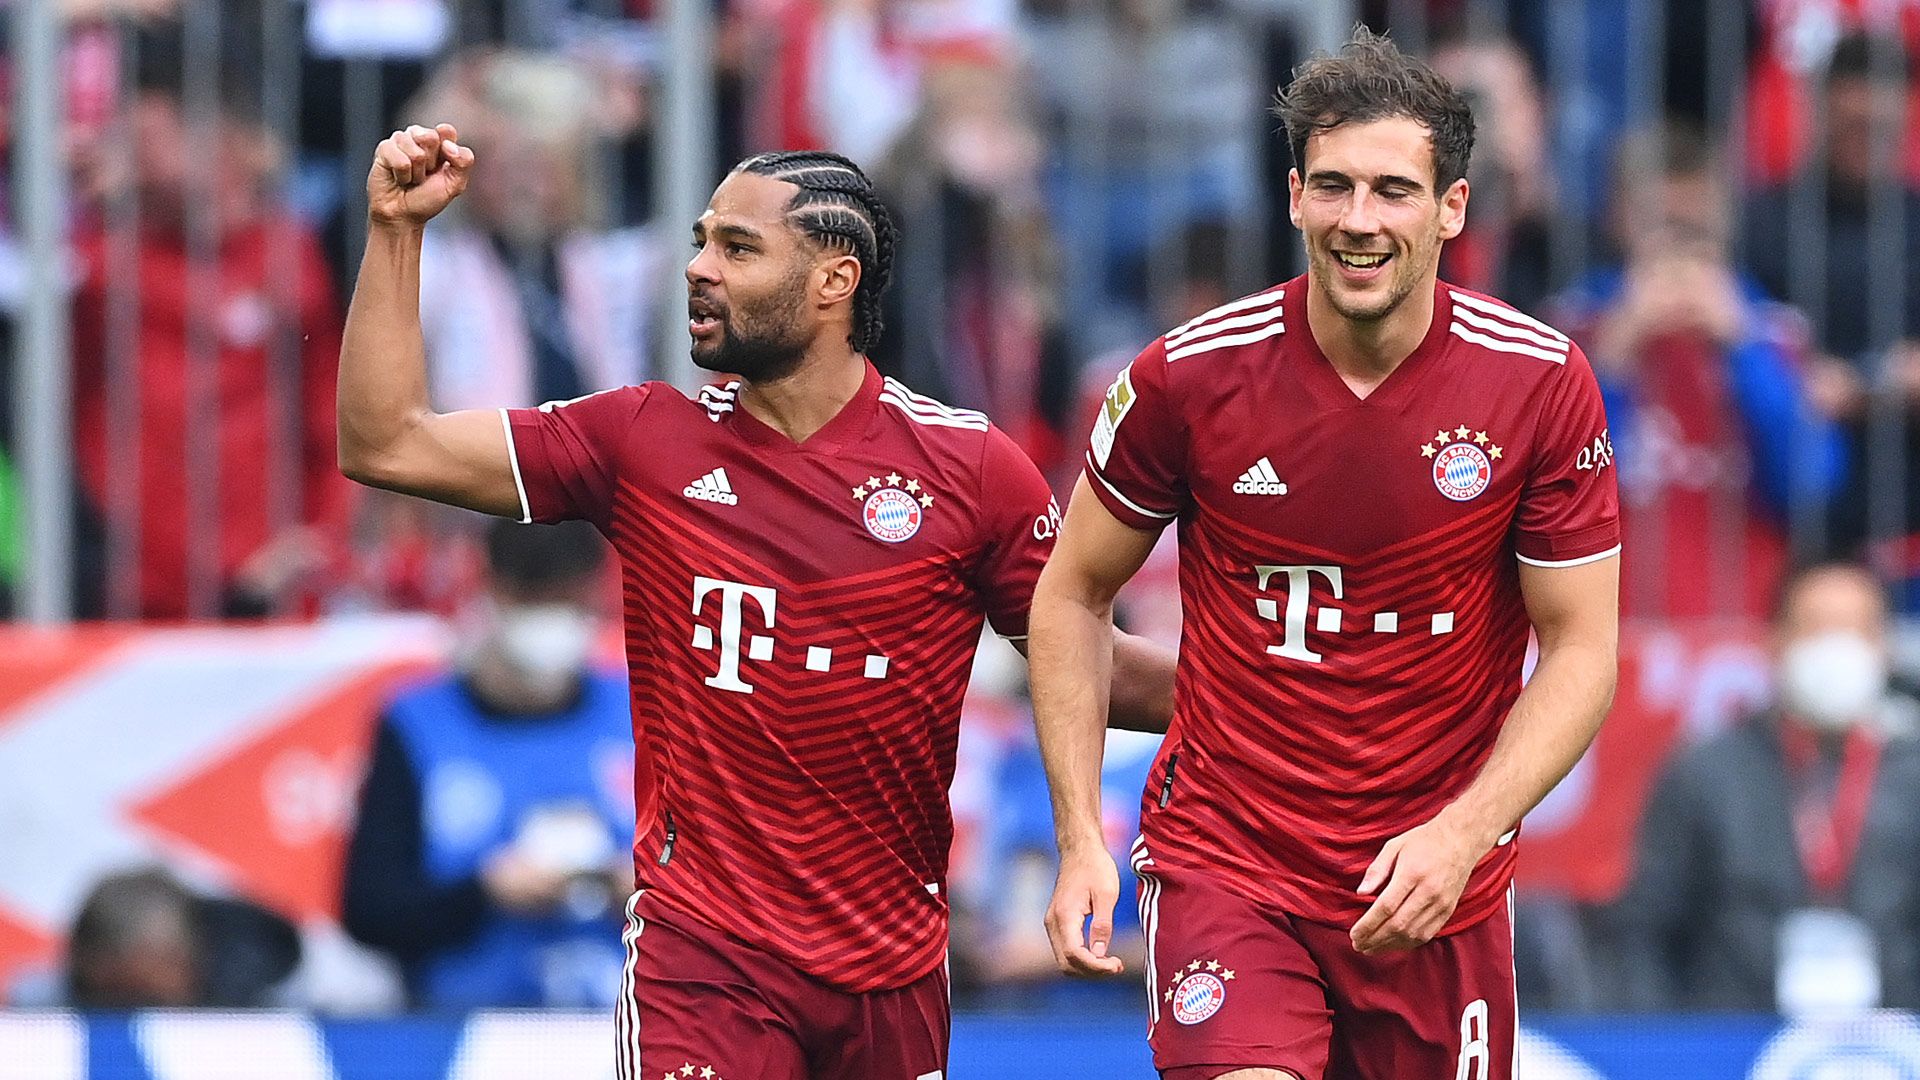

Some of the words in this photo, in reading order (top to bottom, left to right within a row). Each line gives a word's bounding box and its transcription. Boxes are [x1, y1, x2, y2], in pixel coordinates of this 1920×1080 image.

[1437, 454, 1450, 469] FC
[1449, 447, 1487, 469] BAYERN
[682, 485, 738, 506] adidas
[1232, 481, 1288, 496] adidas
[868, 496, 882, 510] FC
[881, 491, 918, 513] BAYERN
[1183, 976, 1219, 991] BAYERN
[1455, 998, 1490, 1080] 8
